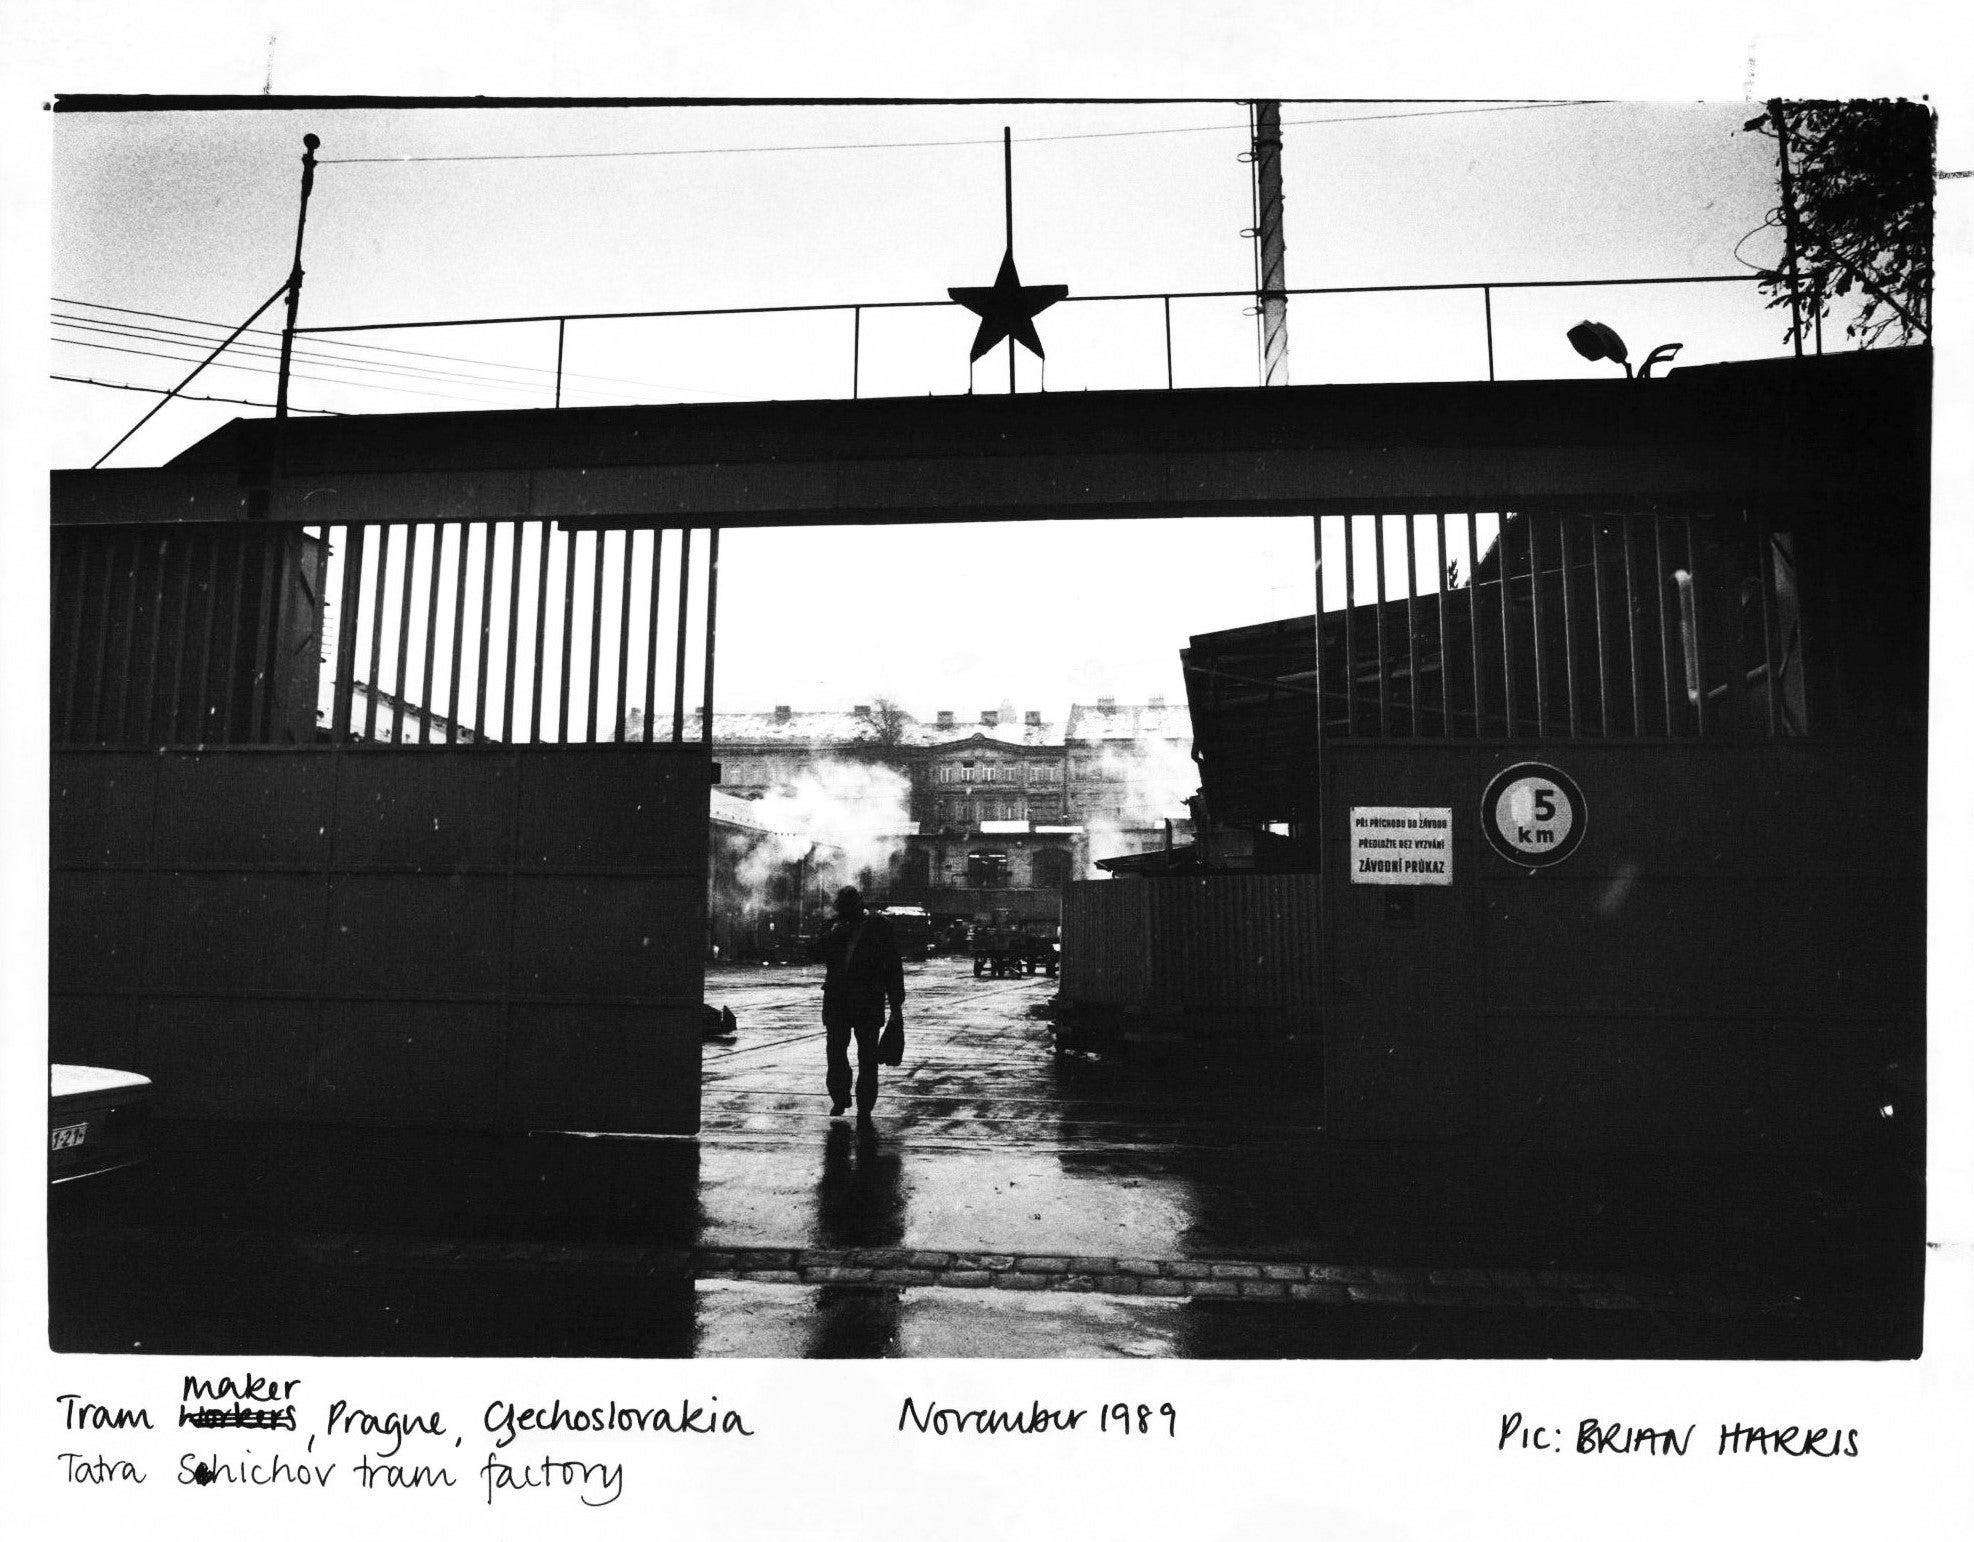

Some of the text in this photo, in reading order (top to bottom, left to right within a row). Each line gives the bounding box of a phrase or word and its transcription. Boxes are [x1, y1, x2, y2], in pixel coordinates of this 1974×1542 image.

[1535, 789, 1556, 821] 5
[1355, 817, 1447, 829] PŘI PŘÍCHODU DO ZÁVODU
[1518, 826, 1554, 843] km
[1358, 838, 1445, 850] PŘEDLOŽTE BEZ VYZVÁNÍ
[1359, 857, 1445, 874] ZÁVODNÍ PRŮKAZ
